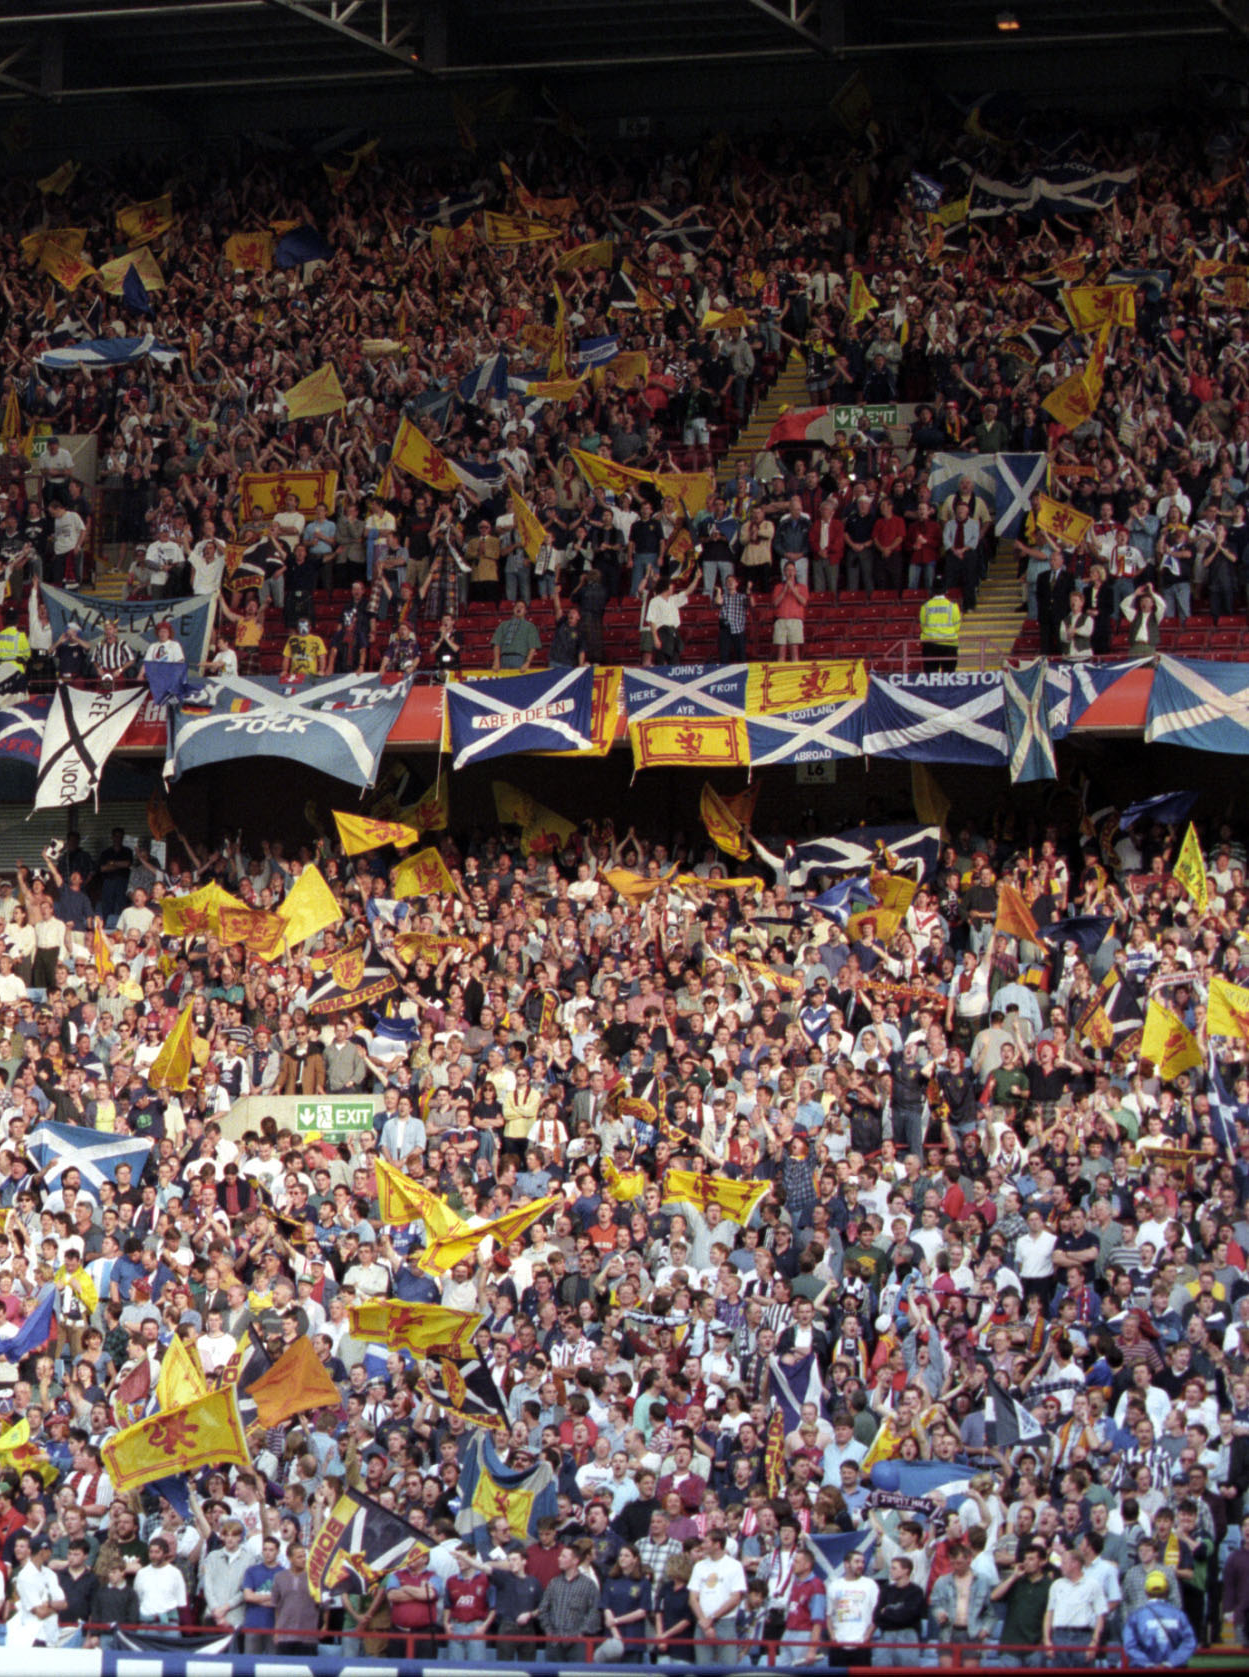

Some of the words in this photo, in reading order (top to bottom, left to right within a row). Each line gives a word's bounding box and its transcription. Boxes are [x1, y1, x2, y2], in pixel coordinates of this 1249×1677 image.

[865, 410, 896, 423] EXIT
[668, 665, 705, 677] JOHN'S
[629, 688, 658, 703] HERE
[709, 682, 739, 696] FROM
[89, 692, 113, 719] REE
[675, 704, 696, 716] AYR
[786, 703, 836, 721] SCOTLAND
[478, 700, 567, 729] ABERDEEN
[224, 717, 312, 735] JOCK
[793, 748, 833, 762] ABROAD
[807, 763, 825, 776] L6
[59, 759, 82, 806] NOCK
[335, 1108, 371, 1124] EXIT
